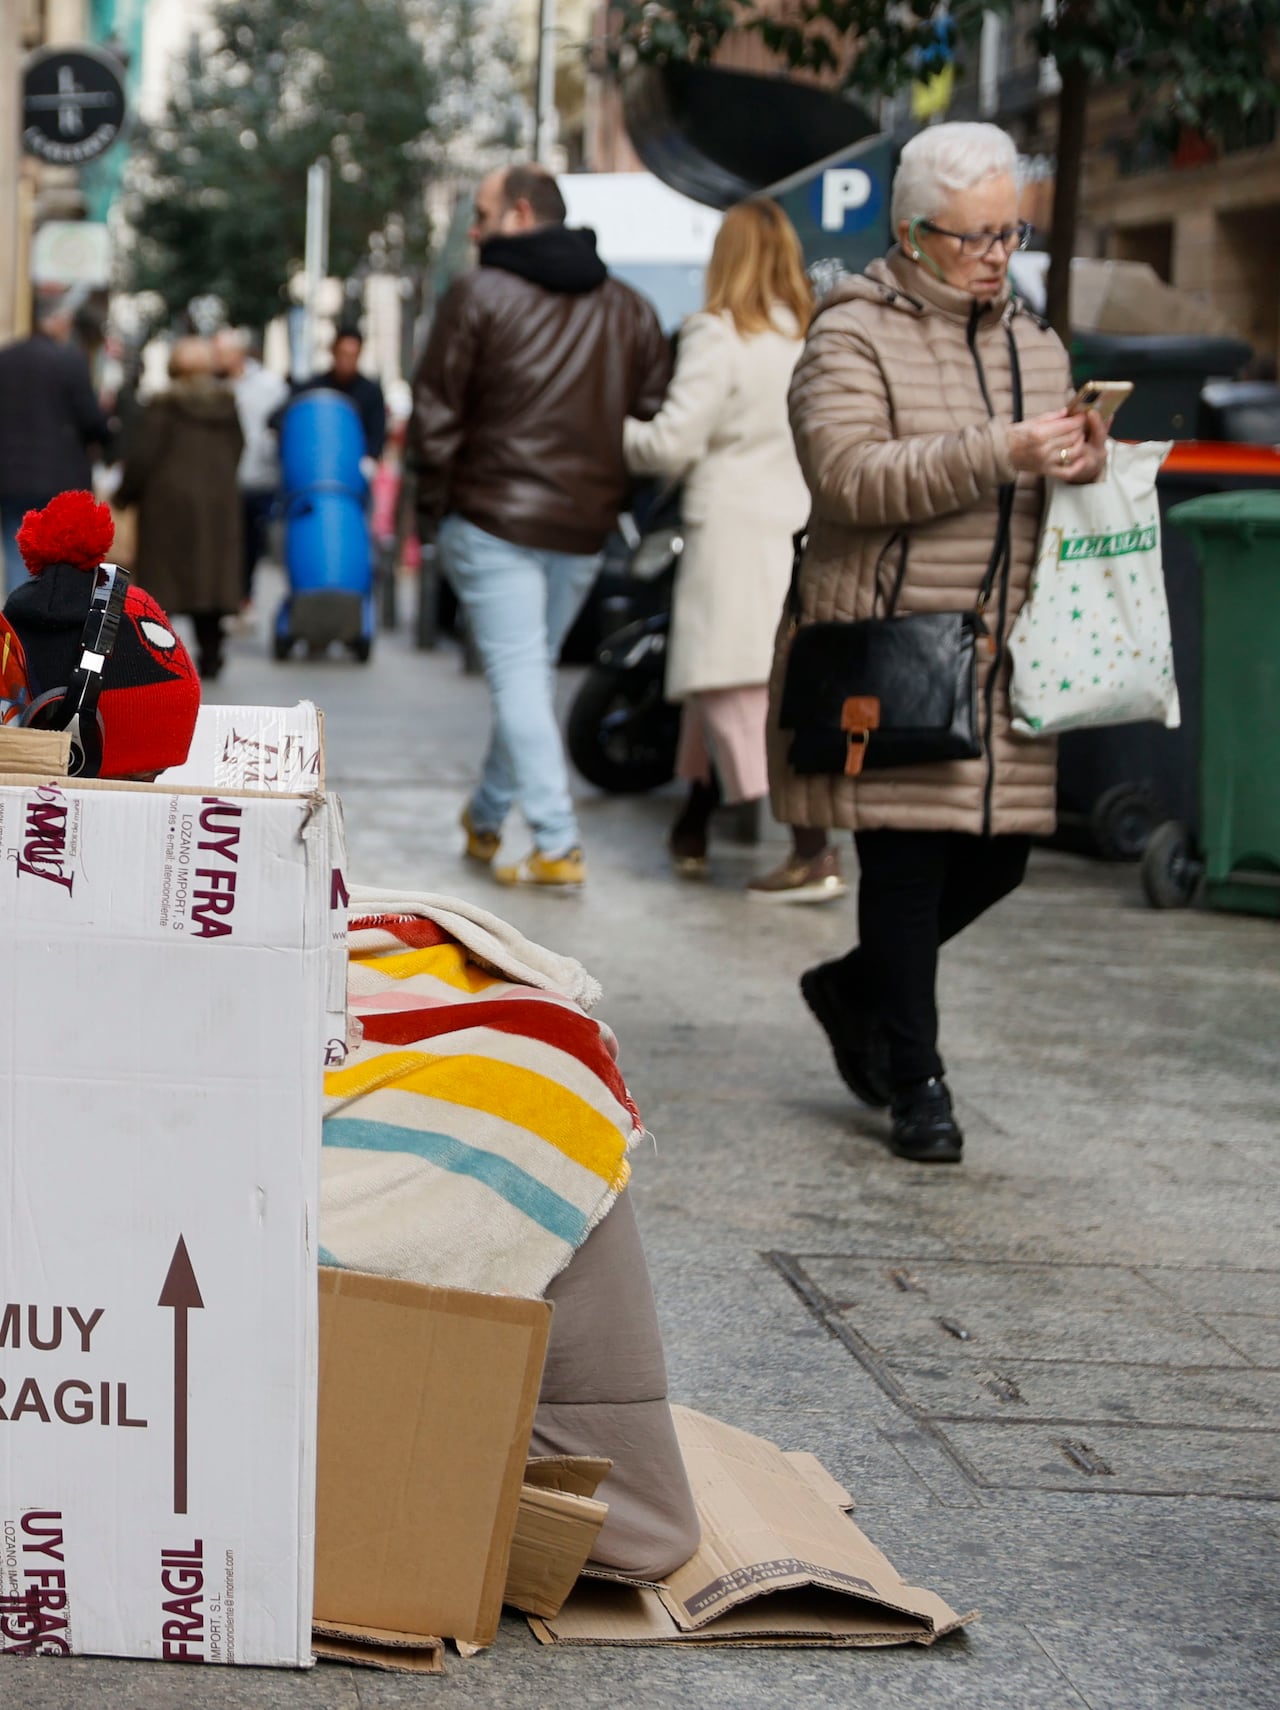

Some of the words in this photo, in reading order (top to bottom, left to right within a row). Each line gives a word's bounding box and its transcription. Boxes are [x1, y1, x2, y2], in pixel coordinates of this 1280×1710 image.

[822, 168, 871, 231] P
[178, 814, 193, 865] LOZANO
[190, 868, 237, 938] FRA
[4, 1520, 17, 1567] LOZANO
[161, 1539, 205, 1662] FRAGIL
